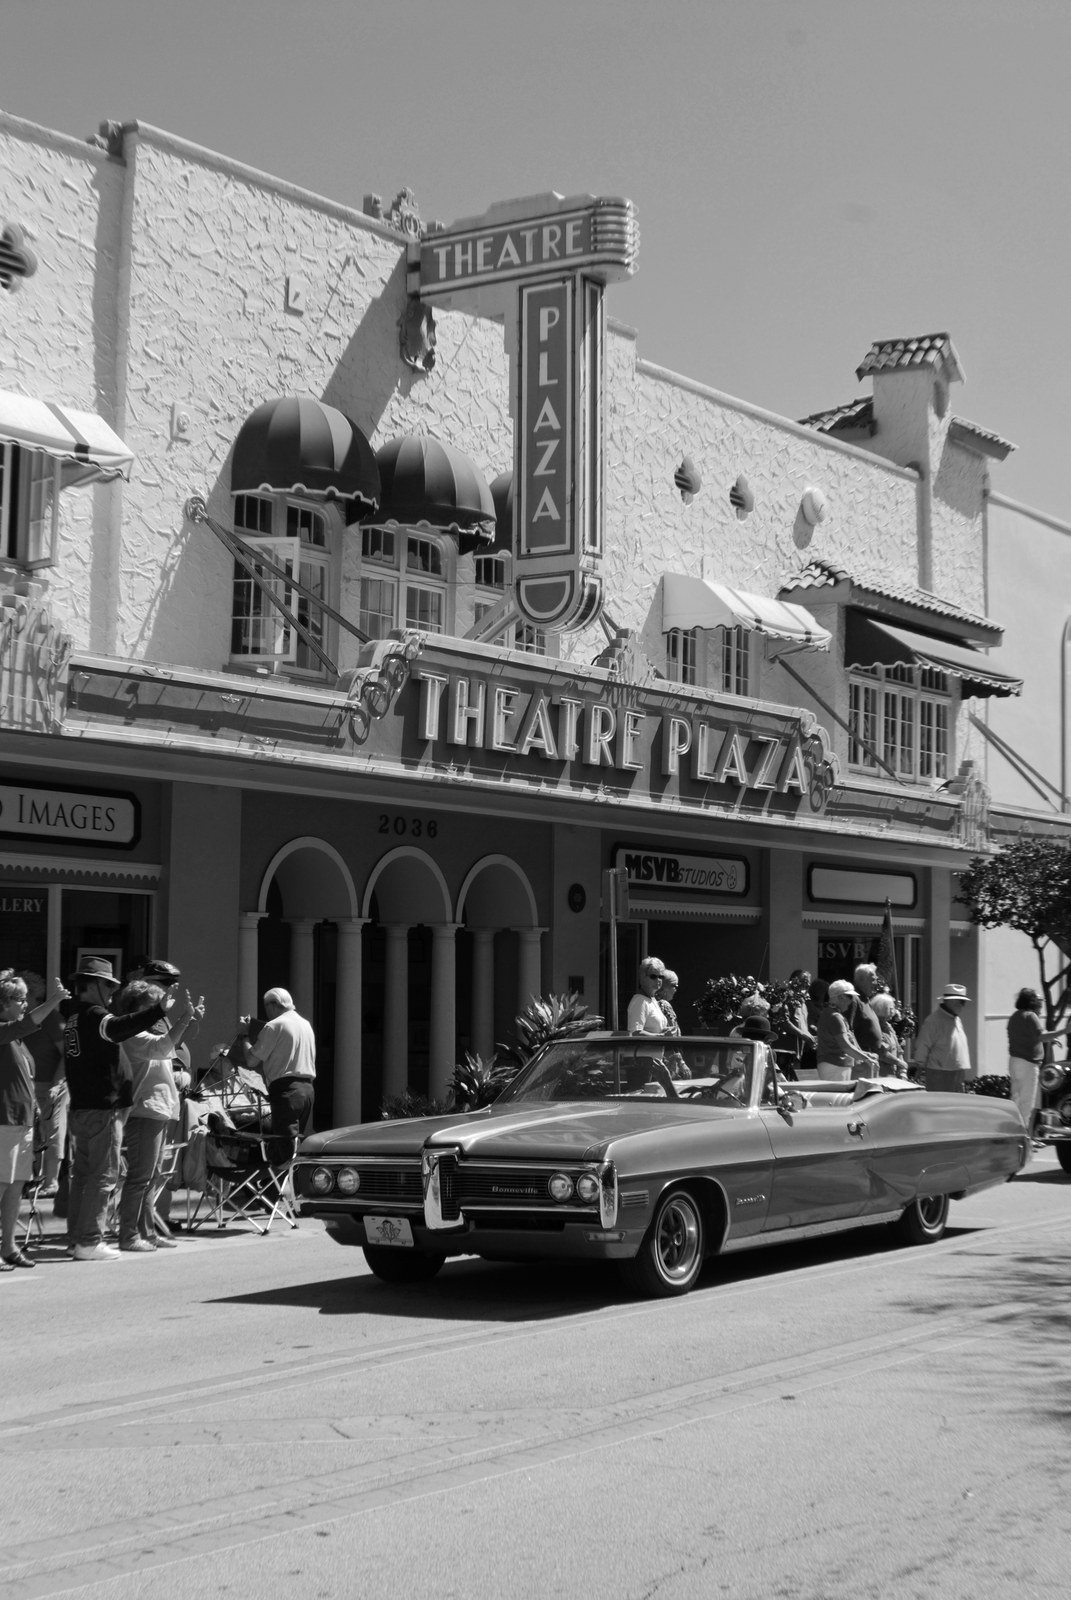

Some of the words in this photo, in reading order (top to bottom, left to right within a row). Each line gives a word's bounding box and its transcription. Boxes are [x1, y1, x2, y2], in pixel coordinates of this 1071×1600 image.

[433, 219, 584, 279] THEATRE
[532, 306, 562, 523] PLAZA
[413, 667, 646, 772] THEATRE
[663, 714, 808, 797] PLAZA
[17, 793, 117, 832] IMAGES
[378, 814, 439, 838] 2036
[624, 853, 680, 883] MSVB
[678, 867, 724, 887] STUDIOS
